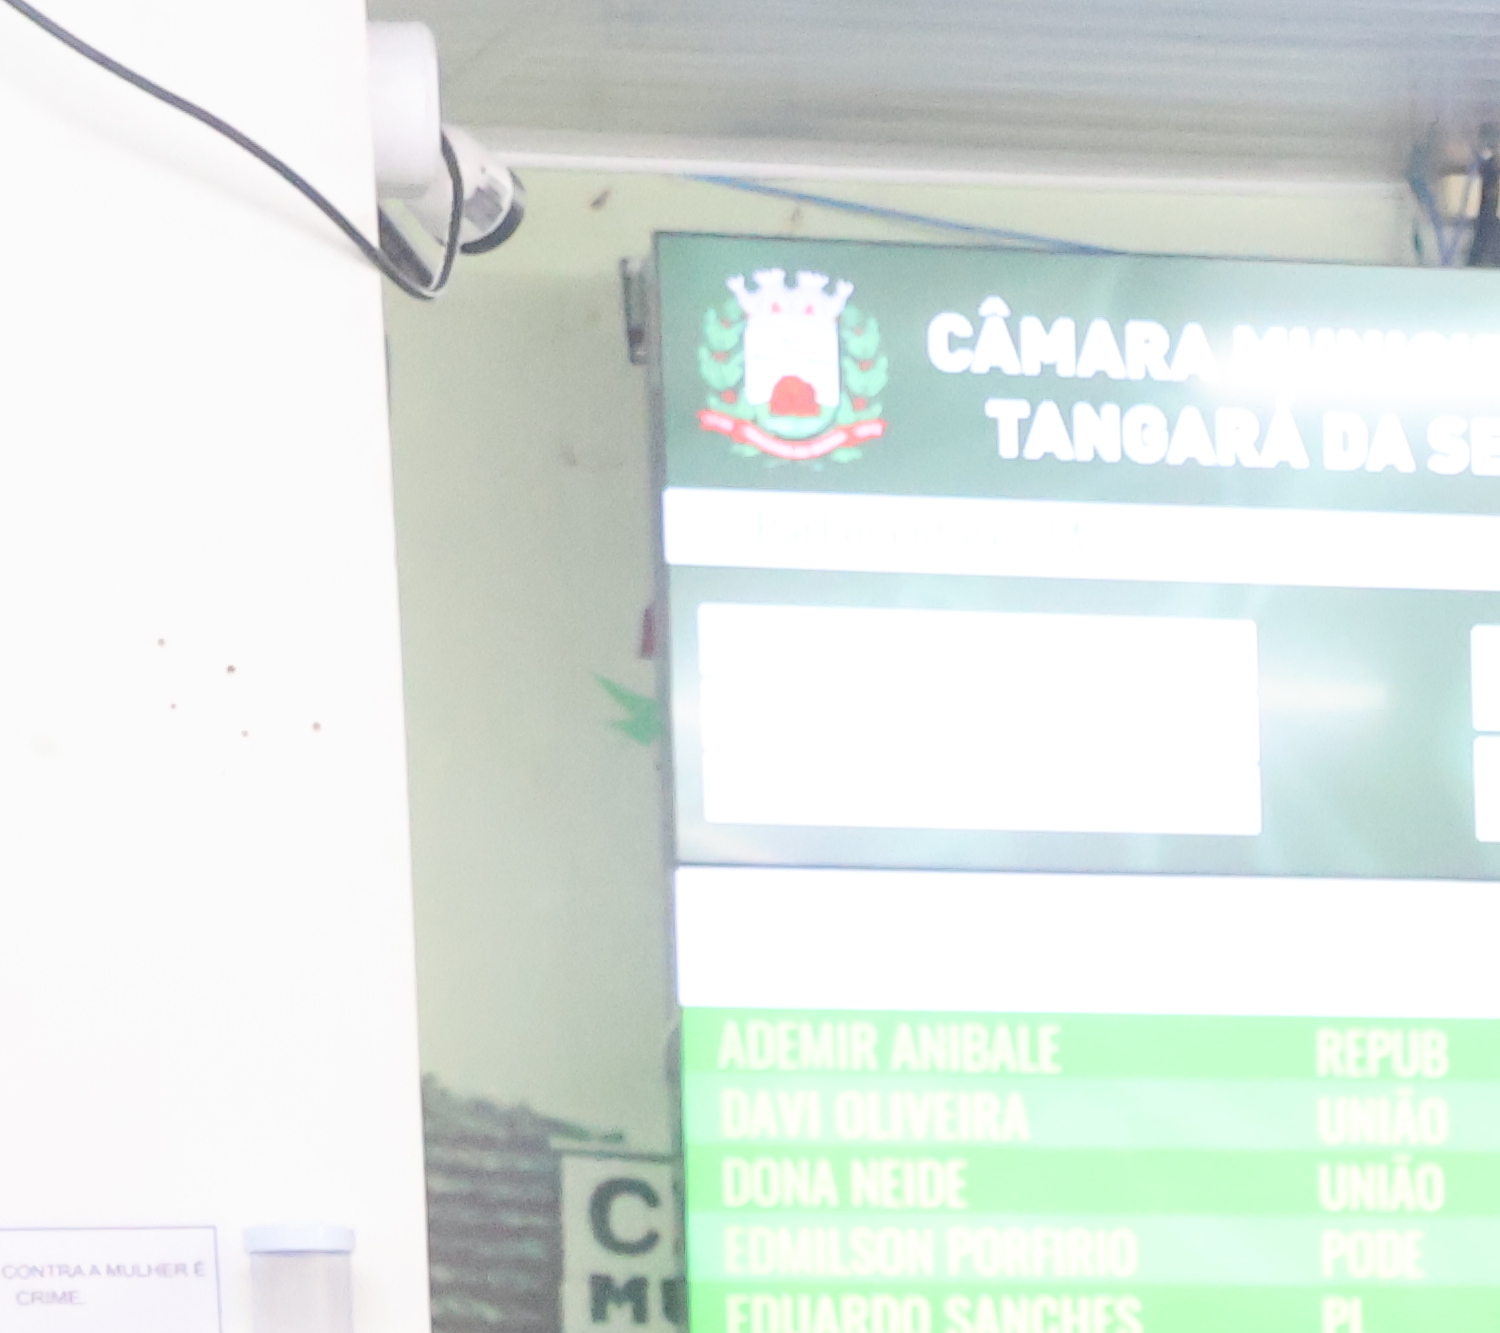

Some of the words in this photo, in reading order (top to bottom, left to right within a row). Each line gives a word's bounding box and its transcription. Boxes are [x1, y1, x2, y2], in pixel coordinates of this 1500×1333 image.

[925, 296, 1218, 381] CÂMARA
[985, 397, 1308, 470] TANGARÁ
[1320, 410, 1415, 475] DA
[716, 1018, 879, 1072] ADEMIR
[889, 1022, 1063, 1075] ANIBALE
[1315, 1027, 1450, 1080] REPUB
[719, 1087, 825, 1140] DAVI
[833, 1089, 1033, 1143] OLIVEIRA
[1316, 1084, 1450, 1146] UNIÃO
[721, 1156, 841, 1209] DONA
[849, 1157, 969, 1211] NEIDE
[1317, 1152, 1447, 1213] UNIÃO
[1, 1264, 84, 1280] CONTRA
[89, 1264, 101, 1277] A
[105, 1262, 188, 1278] MULHER
[193, 1259, 206, 1277] É
[723, 1223, 936, 1277] EDMILSON
[944, 1226, 1140, 1278] PORFIRIO
[1319, 1227, 1426, 1281] PODE
[15, 1290, 80, 1305] CRIME
